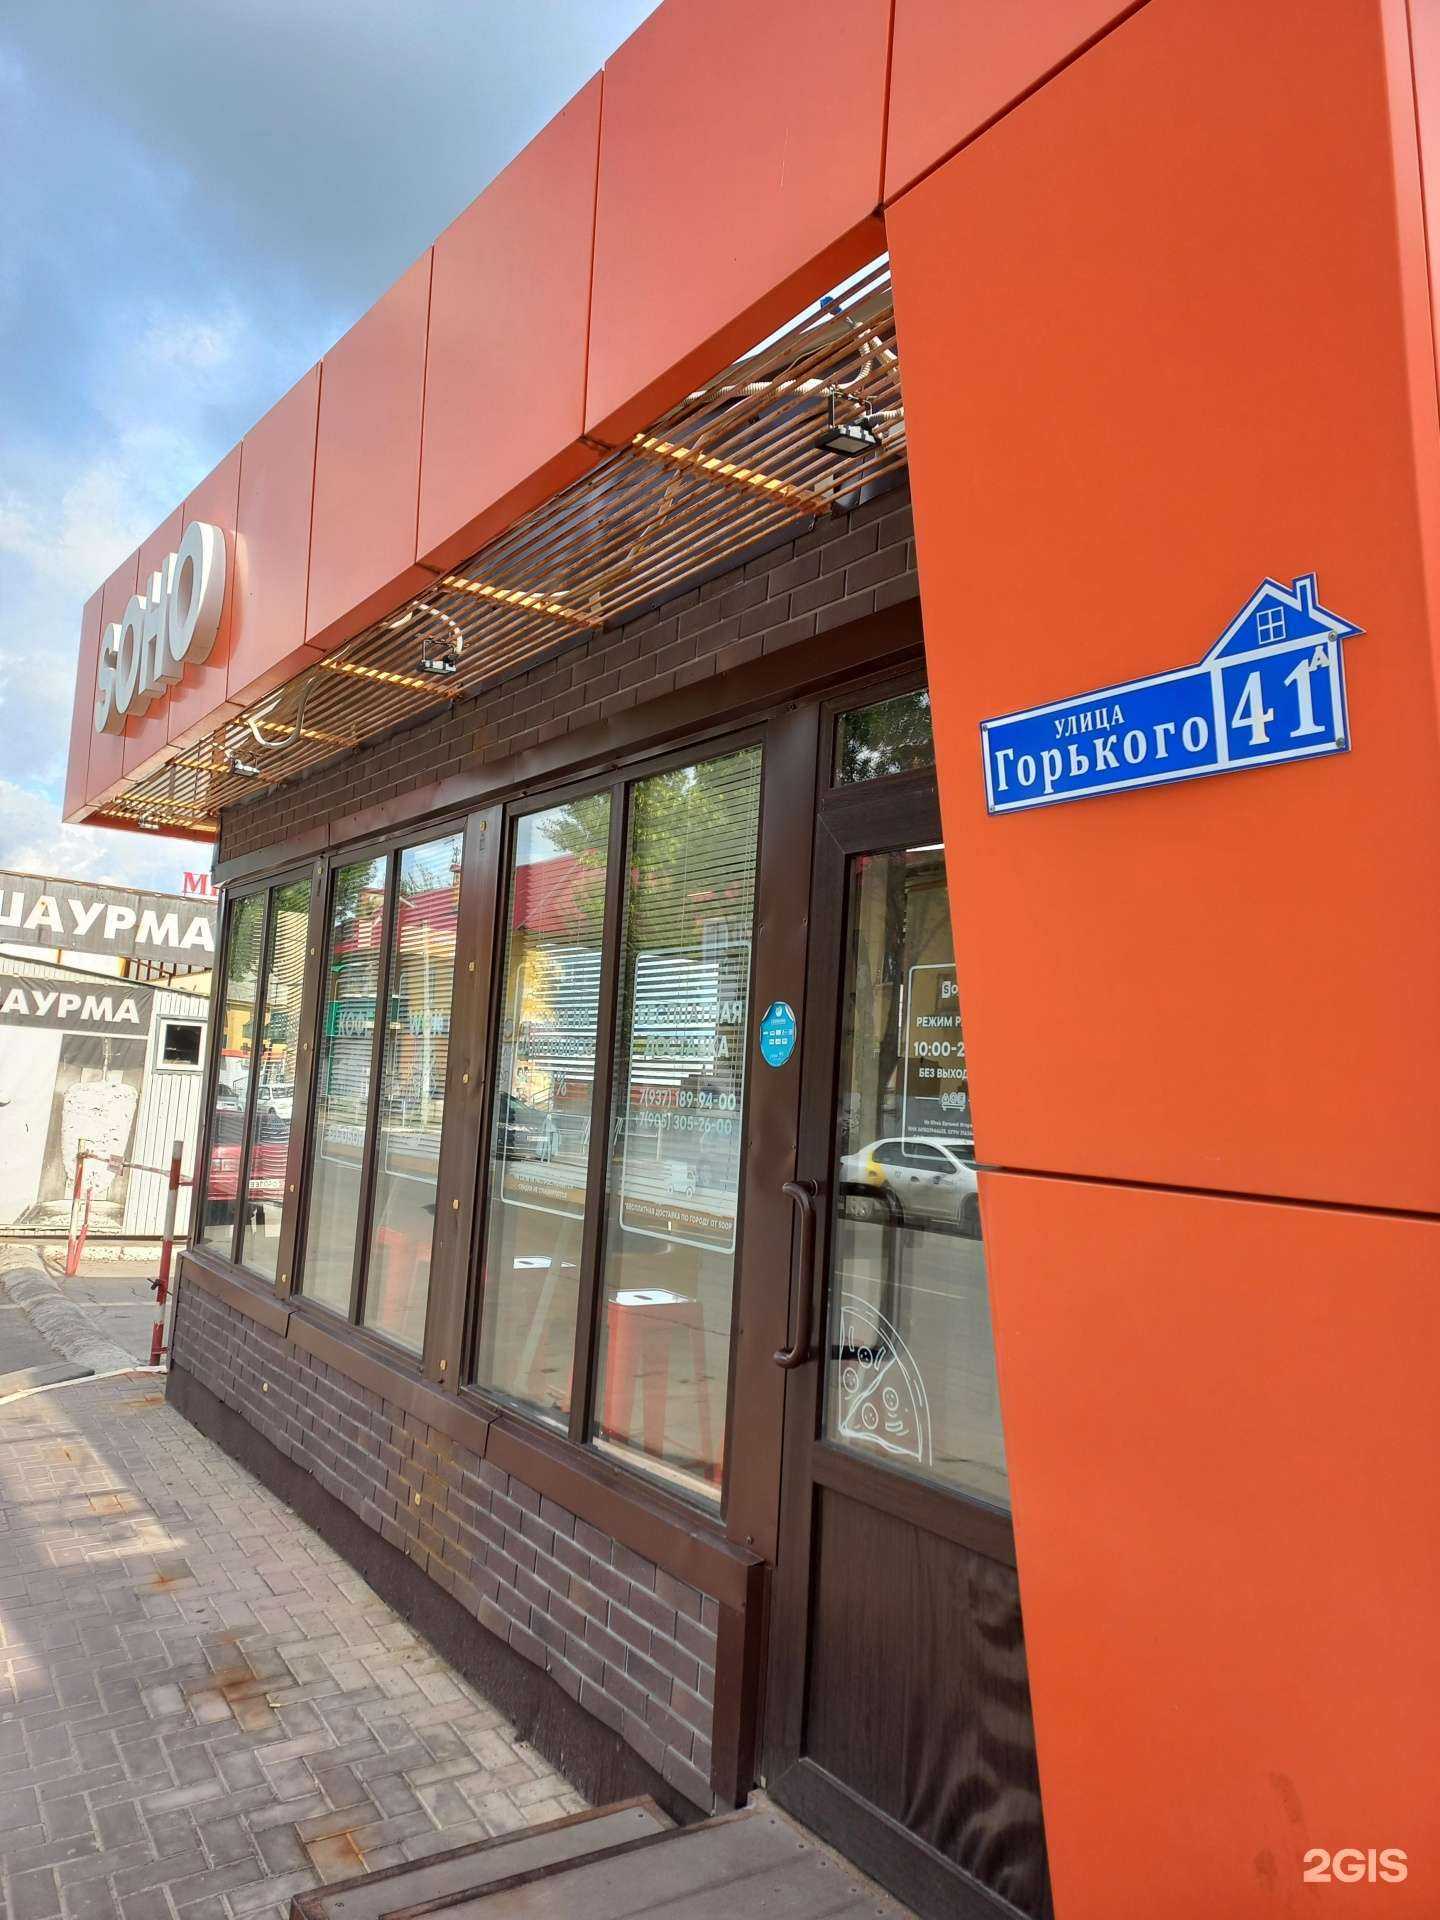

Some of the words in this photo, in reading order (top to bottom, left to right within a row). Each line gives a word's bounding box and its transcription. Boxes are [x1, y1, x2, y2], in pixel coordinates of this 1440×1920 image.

[95, 521, 226, 736] SOHO
[1054, 703, 1126, 740] УЛИЦА
[994, 716, 1209, 794] Горького
[916, 1015, 952, 1028] РЕЖИМ
[918, 1067, 935, 1079] БЕЗ
